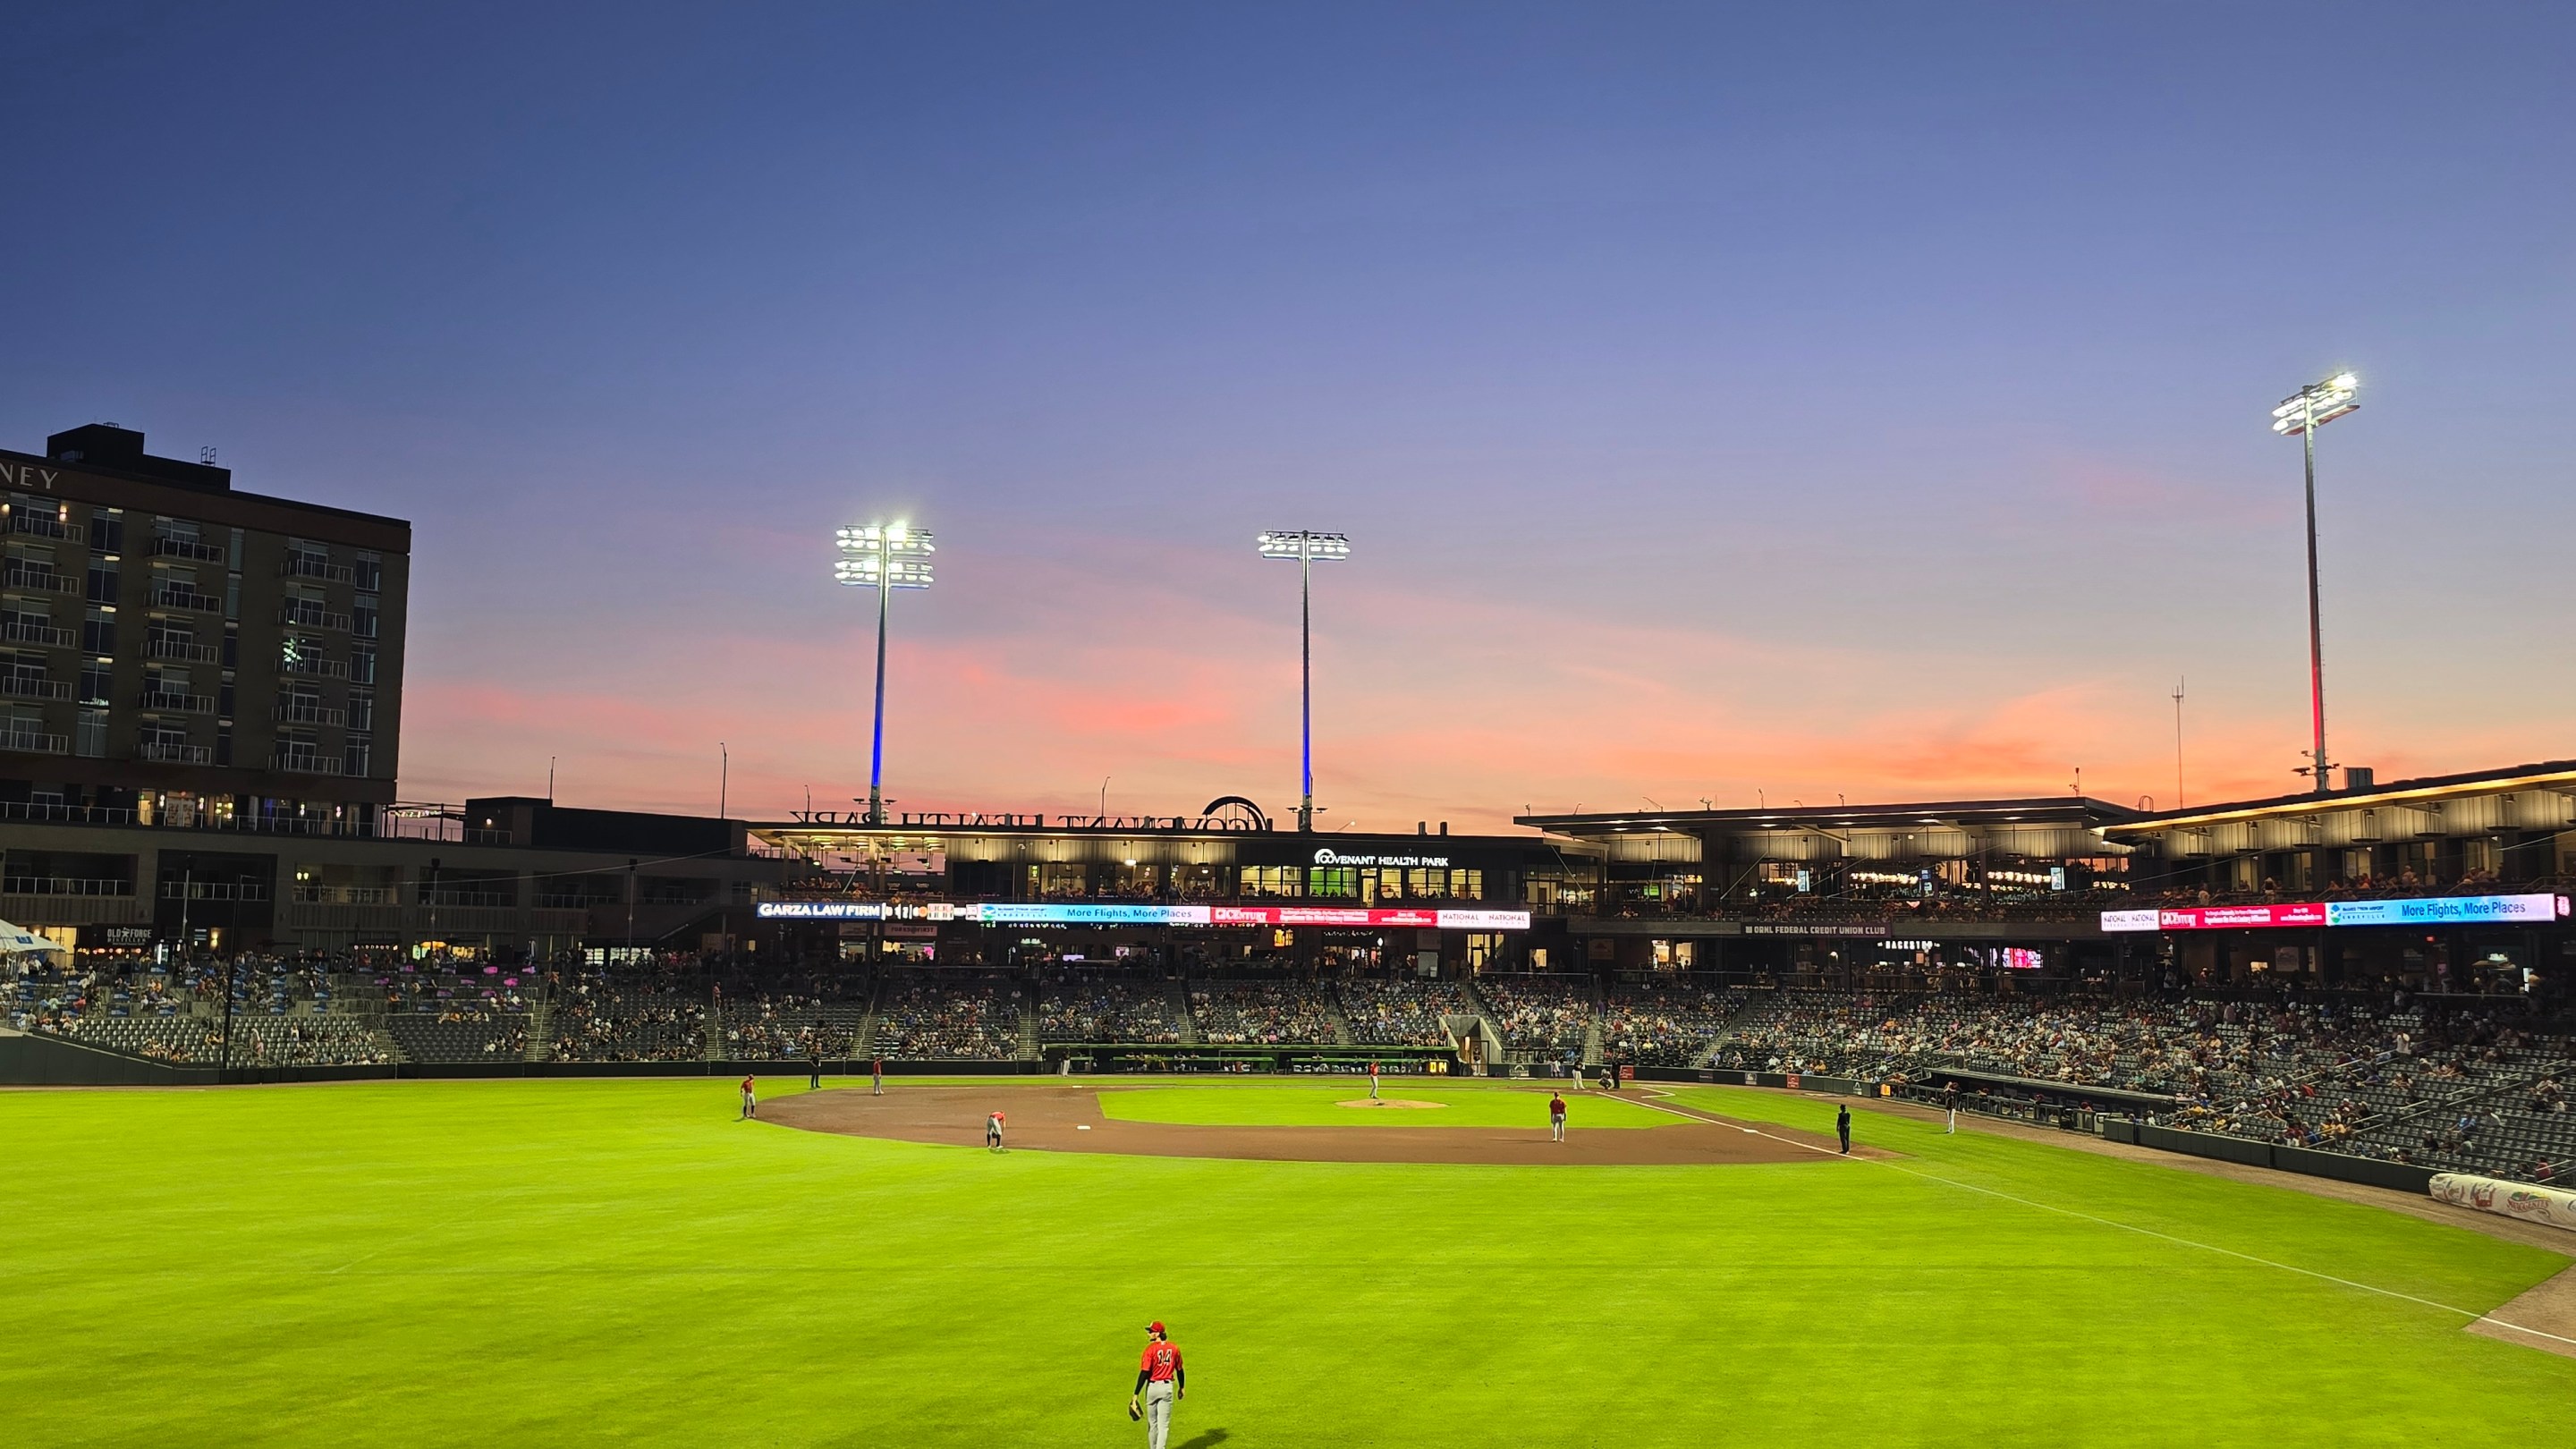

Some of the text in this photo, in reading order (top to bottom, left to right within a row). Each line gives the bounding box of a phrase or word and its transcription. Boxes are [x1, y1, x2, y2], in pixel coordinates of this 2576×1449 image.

[0, 462, 58, 489] NEY
[1315, 852, 1449, 867] COVENANT HEALTH PARK
[758, 903, 812, 916] GARZA
[812, 904, 845, 916] LAW
[846, 905, 880, 916] FIRM
[1067, 909, 1192, 919] More Flights, More Places
[2402, 902, 2526, 919] More Flights, More Places
[106, 928, 152, 938] OLD FORGE
[1754, 926, 1885, 935] ORNL FEDERAL CREDIT UNION CLUB
[1157, 1349, 1173, 1366] 14
